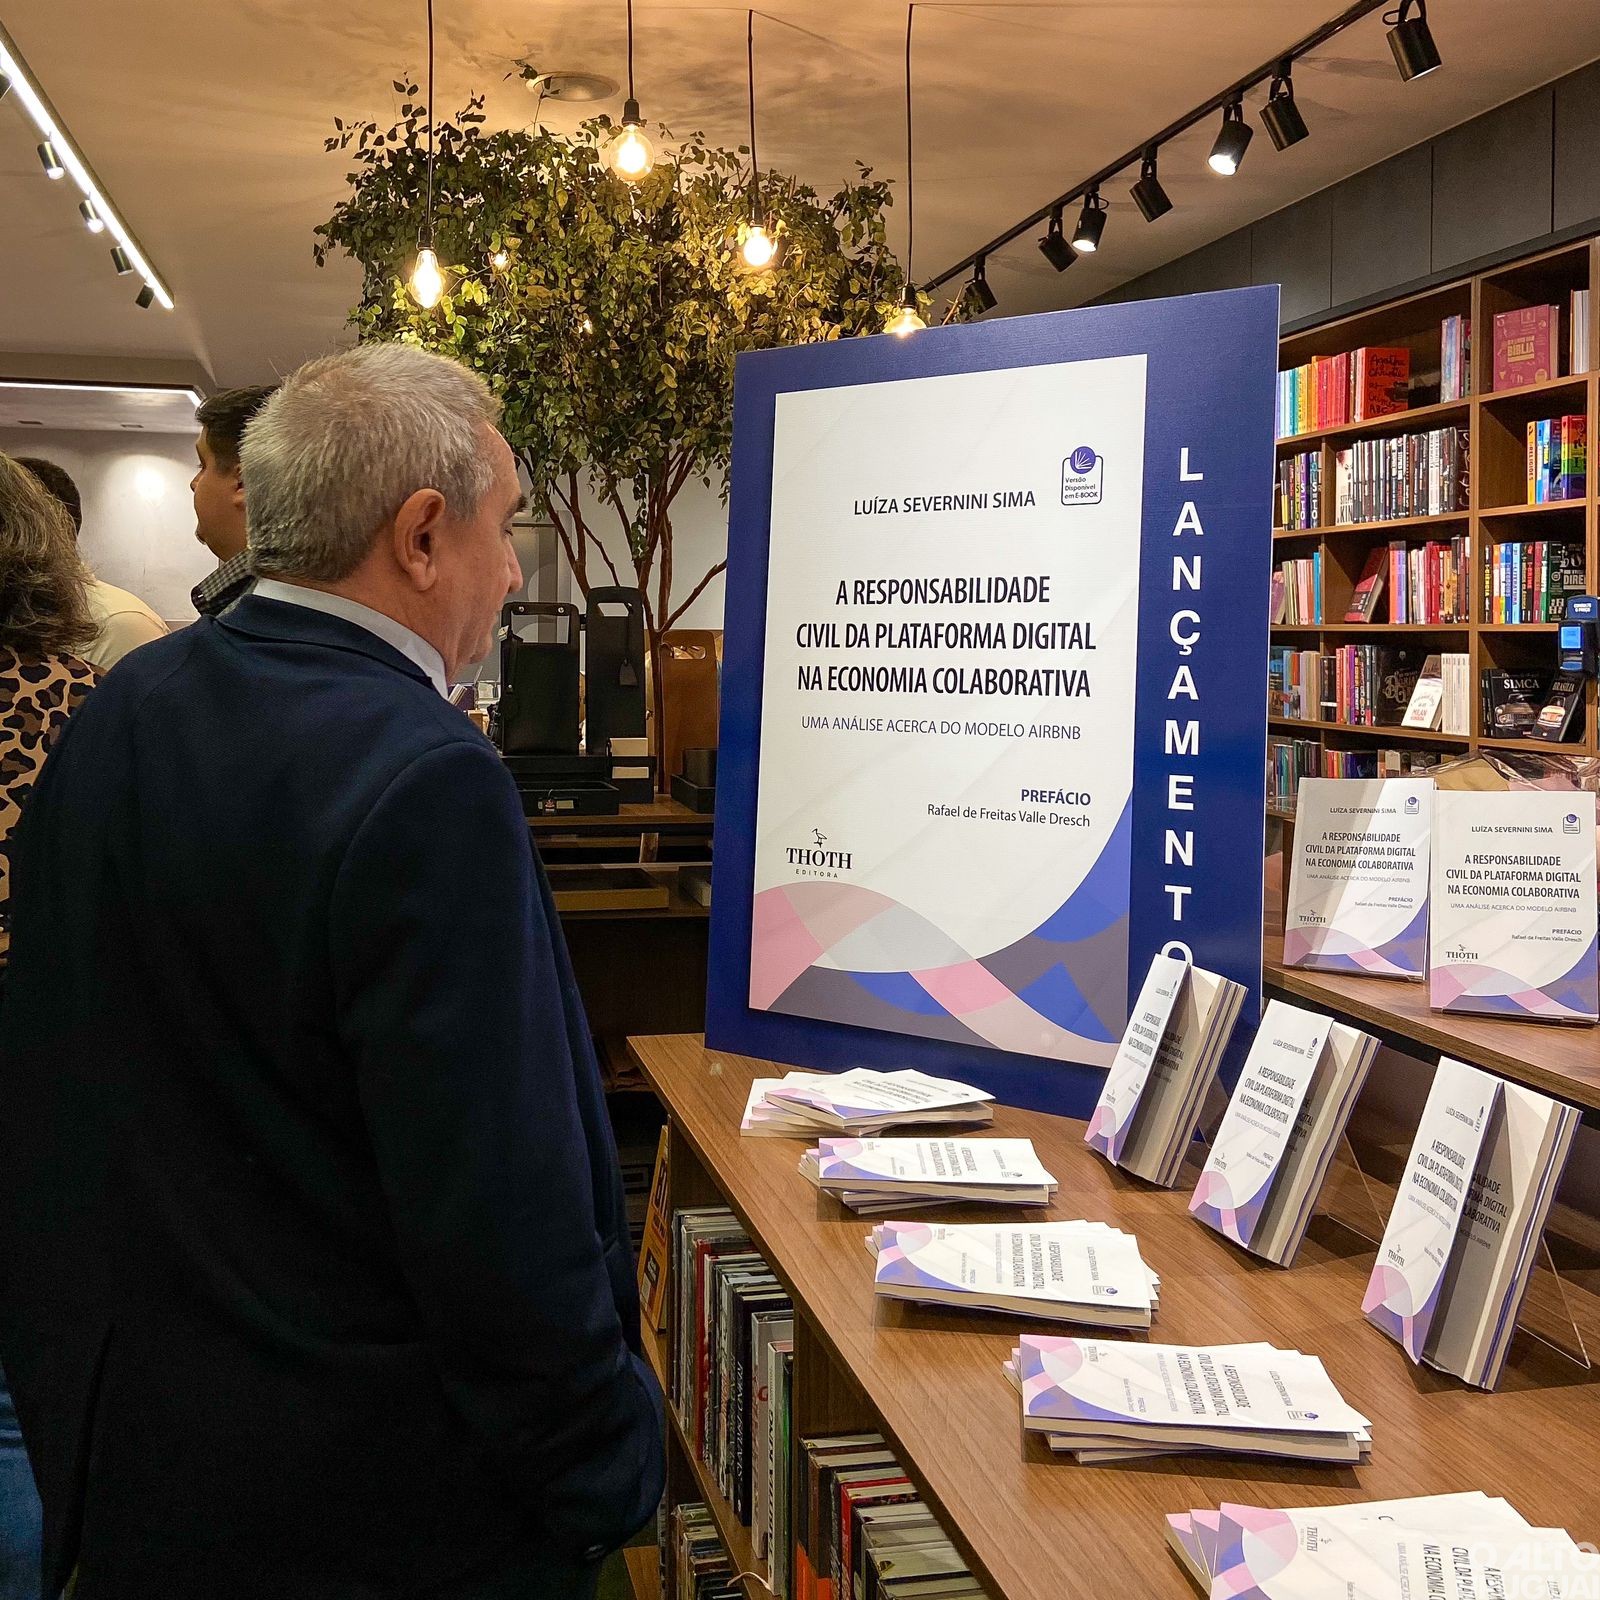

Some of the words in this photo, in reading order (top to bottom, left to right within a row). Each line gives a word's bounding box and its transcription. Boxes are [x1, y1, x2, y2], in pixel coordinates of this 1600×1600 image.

[1065, 484, 1096, 492] Disponível
[1075, 491, 1098, 499] E-BOOK
[854, 496, 899, 515] LUÍZA
[903, 494, 988, 513] SEVERNINI
[992, 491, 1035, 508] SIMA
[836, 580, 848, 605] A
[854, 576, 1050, 605] RESPONSABILIDADE
[796, 623, 840, 648] CIVIL
[845, 624, 870, 649] DA
[875, 623, 1006, 649] PLATAFORMA
[1012, 622, 1096, 650] DIGITAL
[798, 666, 822, 691] NA
[828, 666, 928, 693] ECONOMIA
[932, 667, 1091, 697] COLABORATIVA
[1503, 679, 1540, 689] SIMCA
[801, 716, 829, 729] UMA
[832, 715, 883, 732] ANÁLISE
[886, 719, 937, 734] ACERCA
[941, 721, 961, 735] DO
[964, 722, 1024, 738] MODELO
[1028, 724, 1081, 740] AIRBNB
[1021, 788, 1091, 806] PREFÁCIO
[928, 804, 960, 818] Rafael
[962, 806, 977, 819] de
[980, 807, 1016, 822] Freitas
[1018, 810, 1046, 824] Valle
[1049, 813, 1090, 827] Dresch
[1472, 825, 1493, 833] LUÍZA
[1322, 832, 1327, 840] A
[1329, 832, 1401, 843] RESPONSABILIDADE
[786, 847, 853, 870] THOTH
[1305, 845, 1323, 854] CIVIL
[1325, 845, 1335, 854] DA
[1337, 846, 1385, 856] PLATAFORMA
[1387, 847, 1416, 857] DIGITAL
[1305, 858, 1316, 867] NA
[1318, 858, 1356, 868] ECONOMIA
[1358, 860, 1414, 871] COLABORATIVA
[1465, 855, 1471, 864] A
[1473, 855, 1561, 866] RESPONSABILIDADE
[795, 868, 839, 879] EDITORA
[1446, 869, 1468, 880] CIVIL
[1470, 870, 1482, 880] DA
[1484, 870, 1543, 882] PLATAFORMA
[1545, 872, 1581, 883] DIGITAL
[1447, 885, 1460, 895] NA
[1462, 885, 1510, 896] ECONOMIA
[1511, 887, 1580, 899] COLABORATIVA
[1306, 1526, 1318, 1552] THOTH
[1423, 1543, 1441, 1555] NA
[1452, 1547, 1471, 1566] CIVIL
[1424, 1556, 1445, 1594] ECONOMIA
[1456, 1578, 1474, 1600] PLATA
